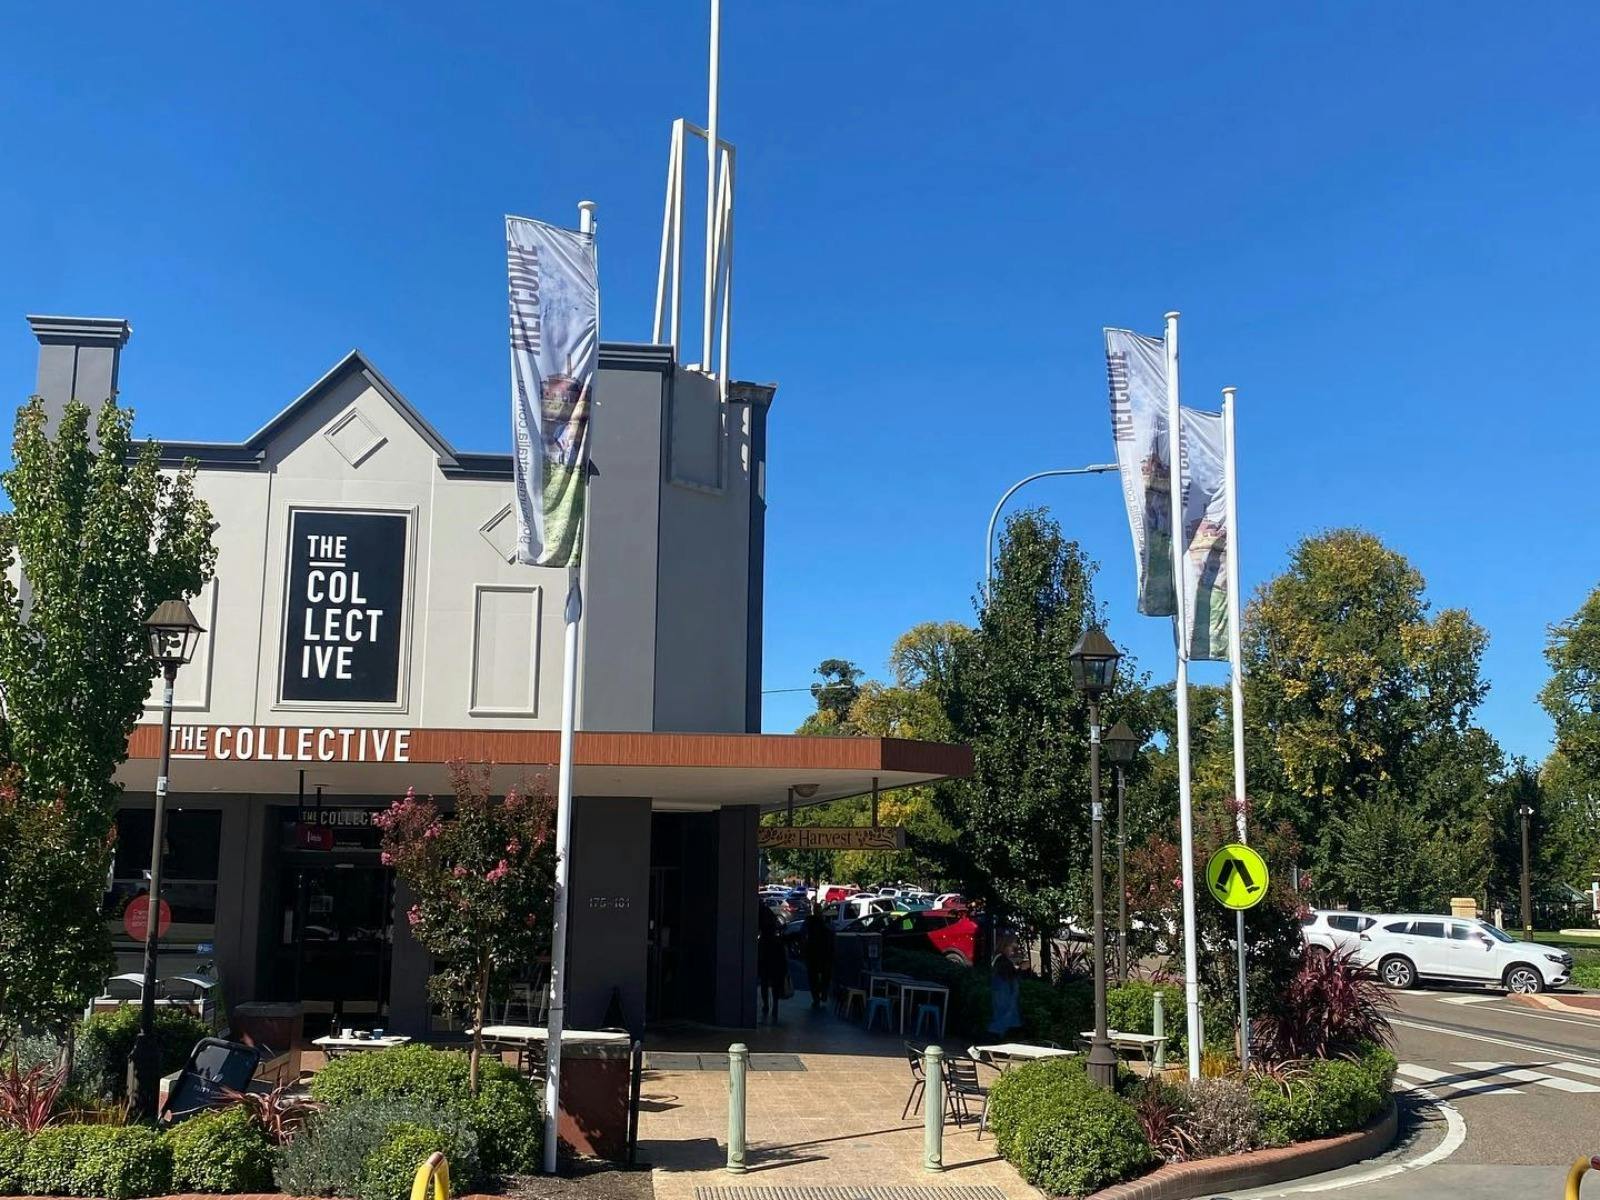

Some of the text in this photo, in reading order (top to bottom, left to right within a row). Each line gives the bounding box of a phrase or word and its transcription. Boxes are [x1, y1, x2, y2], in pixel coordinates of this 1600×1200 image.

[307, 535, 347, 558] THE
[307, 570, 367, 604] COL
[304, 607, 384, 642] LECT
[301, 645, 353, 679] IVE
[171, 727, 411, 763] THE COLLECTIVE
[303, 811, 382, 826] THE COLLECT
[799, 829, 852, 847] Harvest
